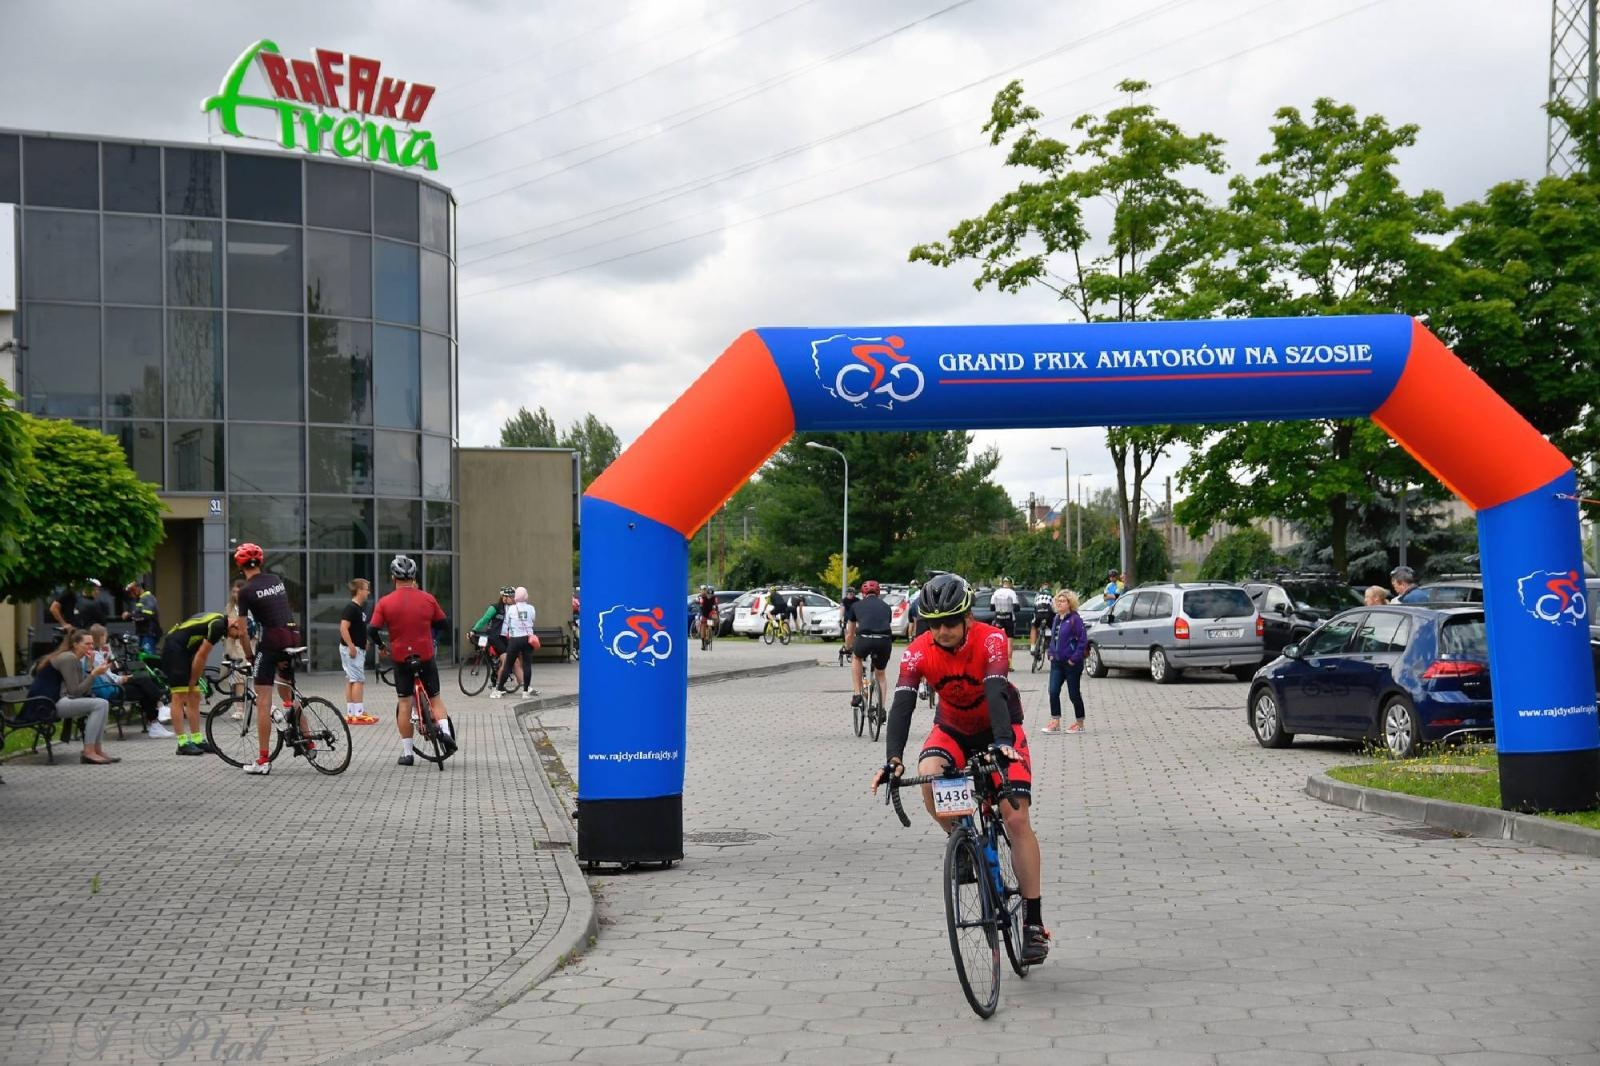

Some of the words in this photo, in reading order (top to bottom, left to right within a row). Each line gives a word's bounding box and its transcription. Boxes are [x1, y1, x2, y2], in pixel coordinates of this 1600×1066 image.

[201, 39, 438, 170] Arena
[256, 48, 436, 123] RAFAKO
[938, 352, 1025, 371] GRAND
[1033, 352, 1088, 370] PRIX
[1096, 343, 1236, 368] AMATORÓW
[1244, 347, 1278, 365] NA
[1285, 344, 1373, 364] SZOSIE
[936, 790, 969, 803] 1436
